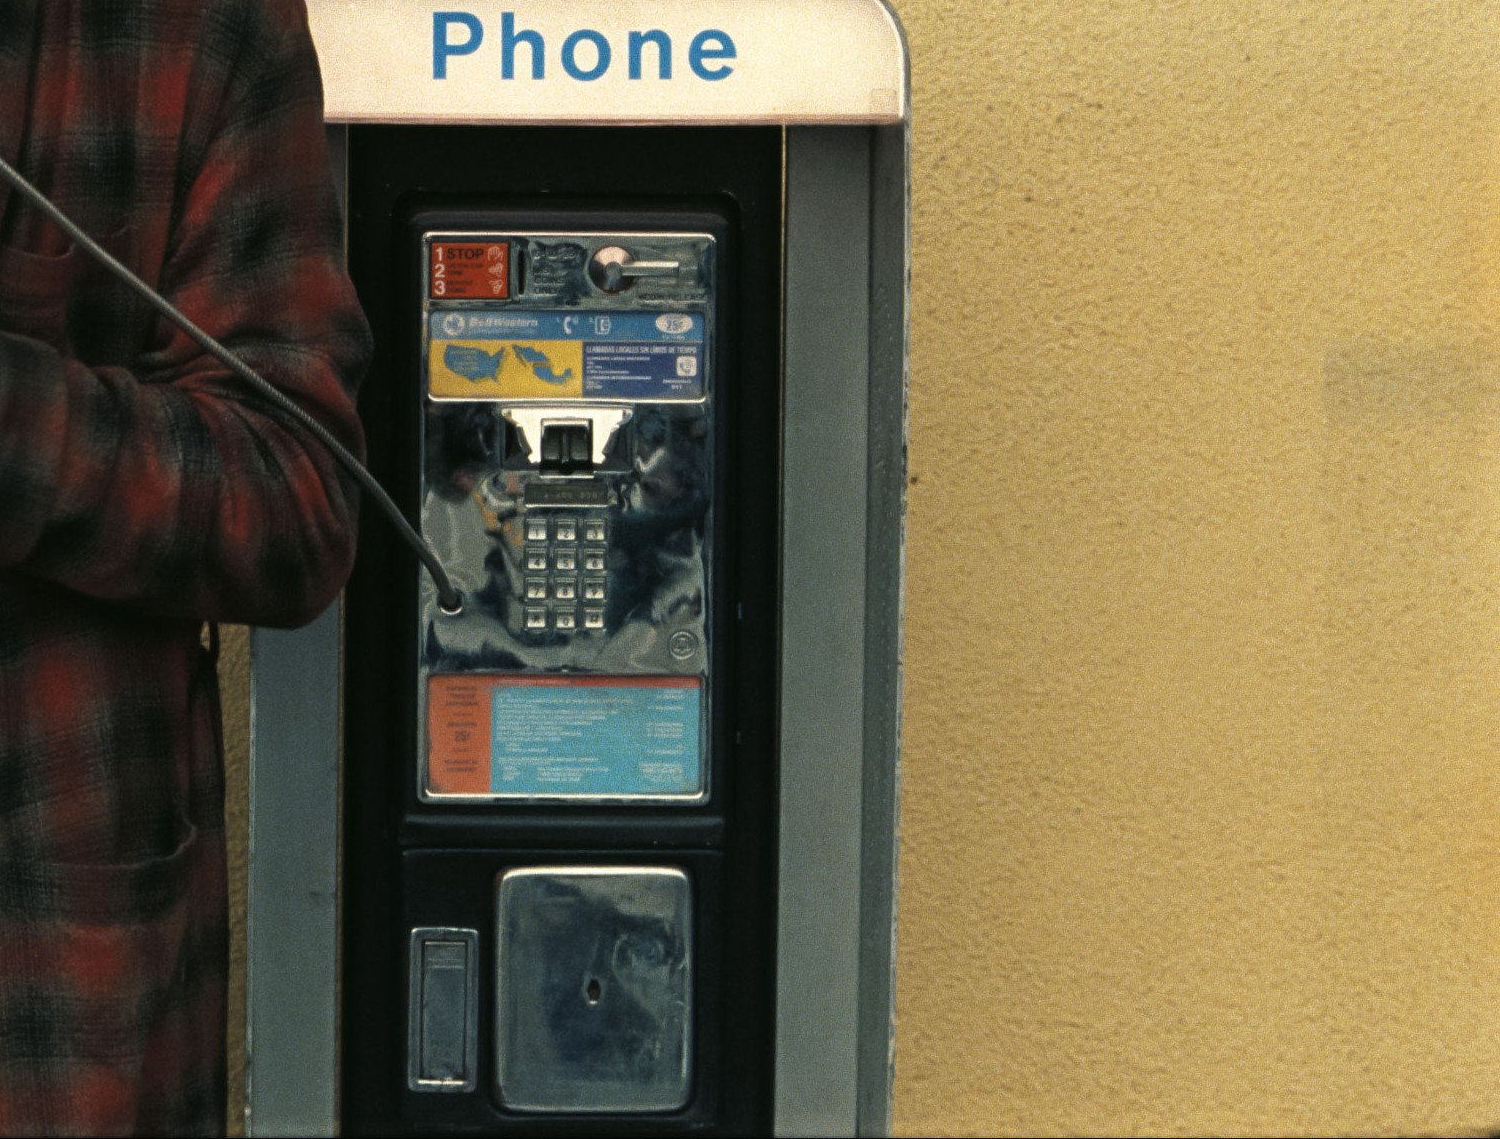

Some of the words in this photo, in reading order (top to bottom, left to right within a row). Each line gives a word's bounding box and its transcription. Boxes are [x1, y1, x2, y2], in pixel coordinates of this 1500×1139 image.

[432, 11, 738, 82] Phone
[435, 246, 443, 261] 1
[447, 247, 484, 260] STOP
[434, 263, 445, 278] 2
[434, 280, 446, 295] 3
